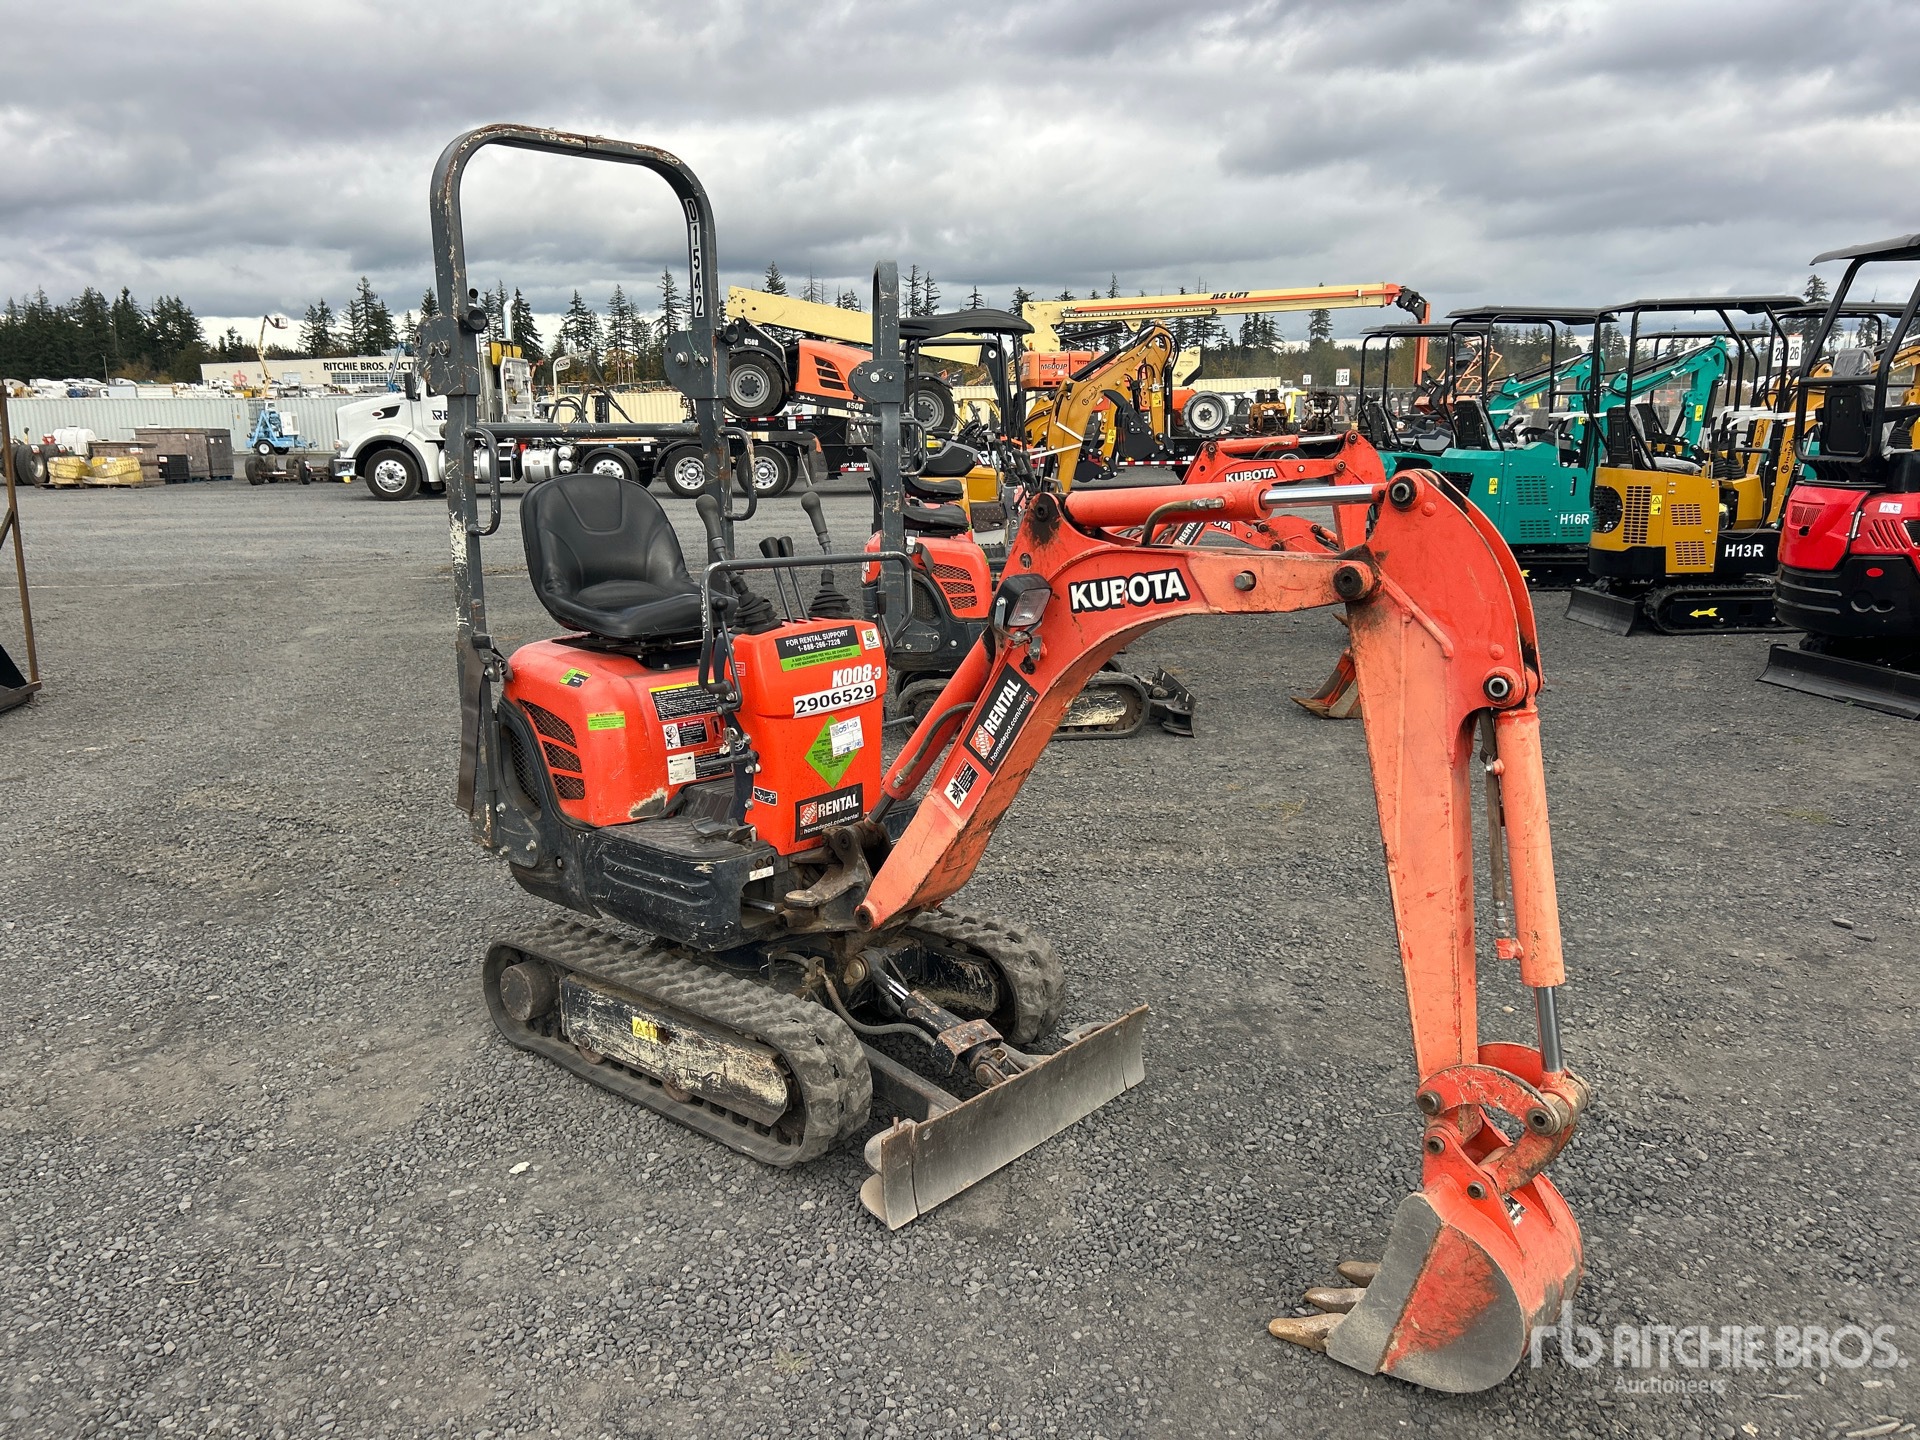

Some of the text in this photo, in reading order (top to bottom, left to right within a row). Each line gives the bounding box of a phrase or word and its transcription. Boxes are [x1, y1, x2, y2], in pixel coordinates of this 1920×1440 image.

[1210, 291, 1249, 300] JLG LIFT
[1789, 347, 1800, 360] 26
[323, 362, 358, 371] RITCHIE
[360, 362, 387, 371] BROS.
[1341, 374, 1348, 382] 24
[1225, 467, 1277, 483] KUBOTA
[1559, 512, 1590, 526] H16R
[1724, 543, 1764, 558] H13R
[1069, 571, 1188, 612] KUBOTA
[785, 629, 848, 647] FOR RENTAL SUPPORT
[831, 663, 882, 689] K008-3
[794, 684, 875, 714] 2906529
[983, 679, 1021, 736] RENTAL
[818, 794, 859, 818] RENTAL
